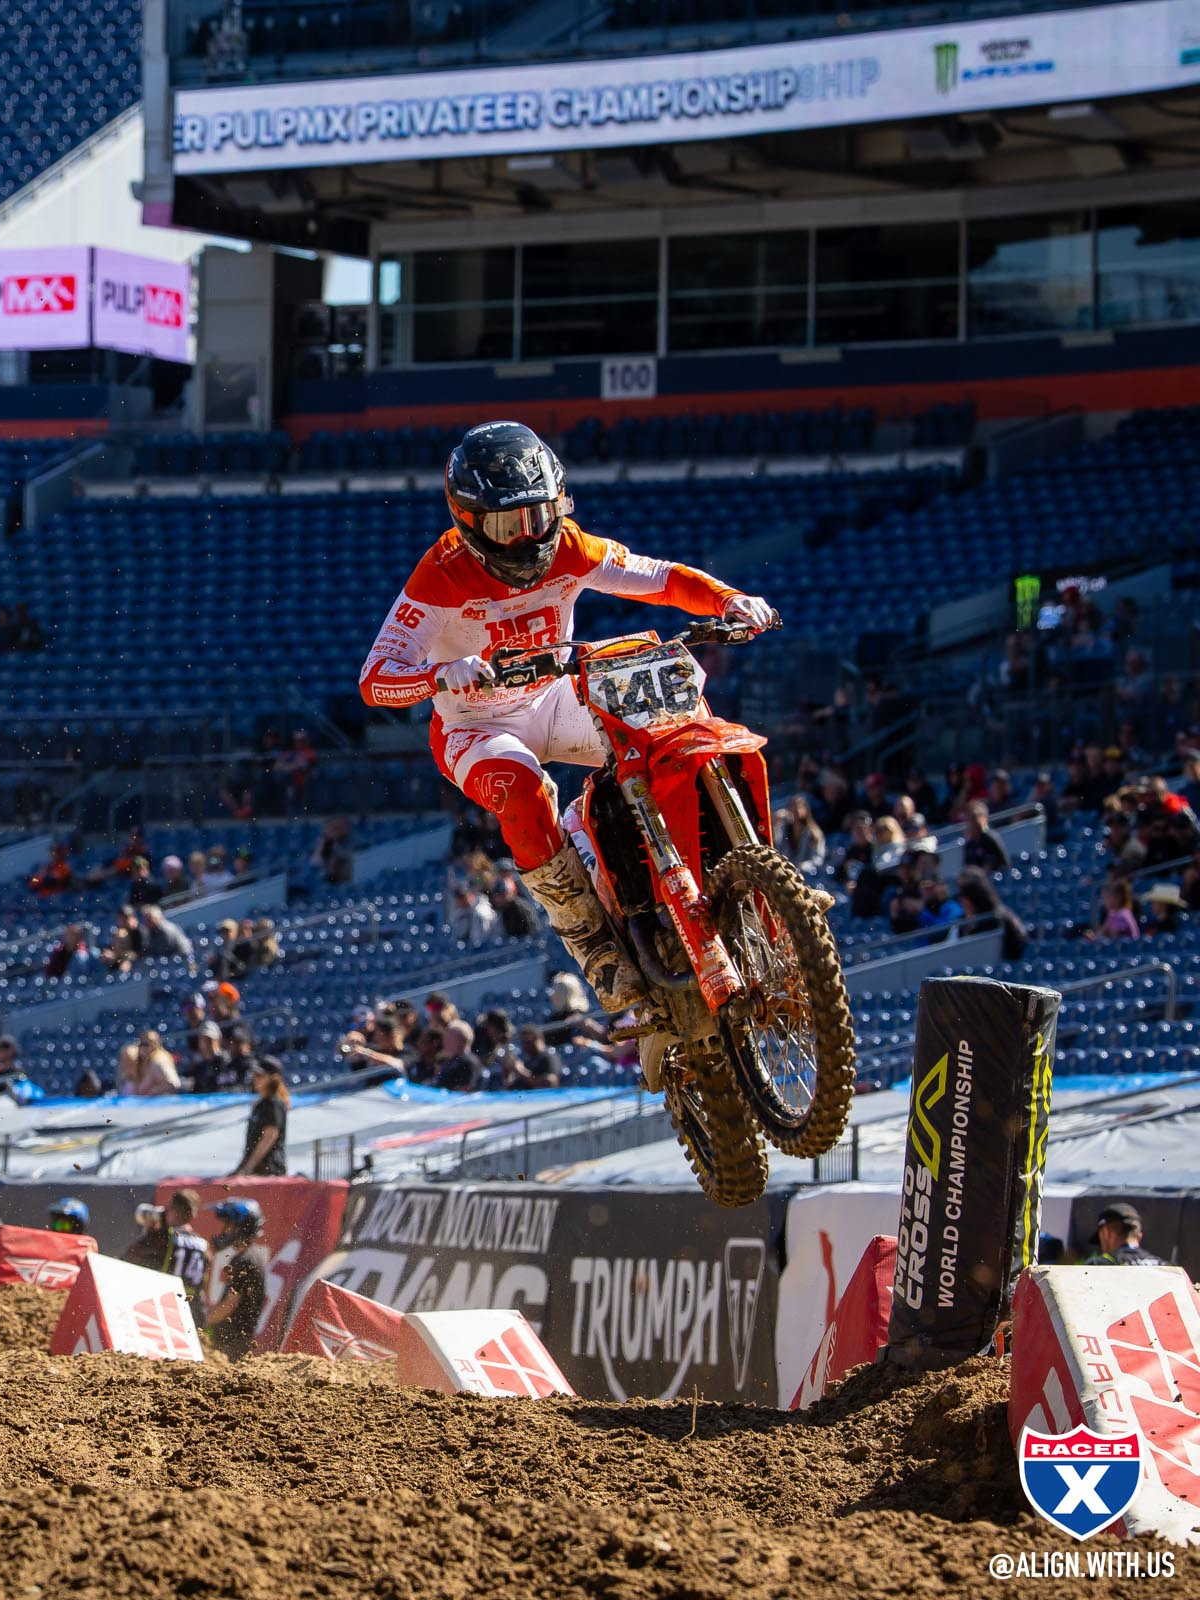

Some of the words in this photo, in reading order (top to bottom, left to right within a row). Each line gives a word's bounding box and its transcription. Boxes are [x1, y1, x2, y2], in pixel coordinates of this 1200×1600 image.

[212, 104, 351, 151] PULPMX
[357, 90, 542, 142] PRIVATEER
[549, 67, 798, 129] CHAMPIONSHIP
[608, 364, 650, 391] 100
[728, 630, 749, 641] ASV
[375, 684, 432, 700] CHAMPION
[505, 673, 531, 686] ASV
[597, 660, 700, 719] 146
[667, 903, 698, 964] DUNLOP
[945, 1039, 974, 1220] CHAMPIONSHIP
[358, 1188, 443, 1246] ROCKY
[433, 1186, 560, 1254] MOUNTAIN
[894, 1164, 915, 1299] MOTO
[905, 1162, 932, 1311] CROSS
[938, 1225, 960, 1309] WORLD
[570, 1256, 723, 1392] TRIUMPH
